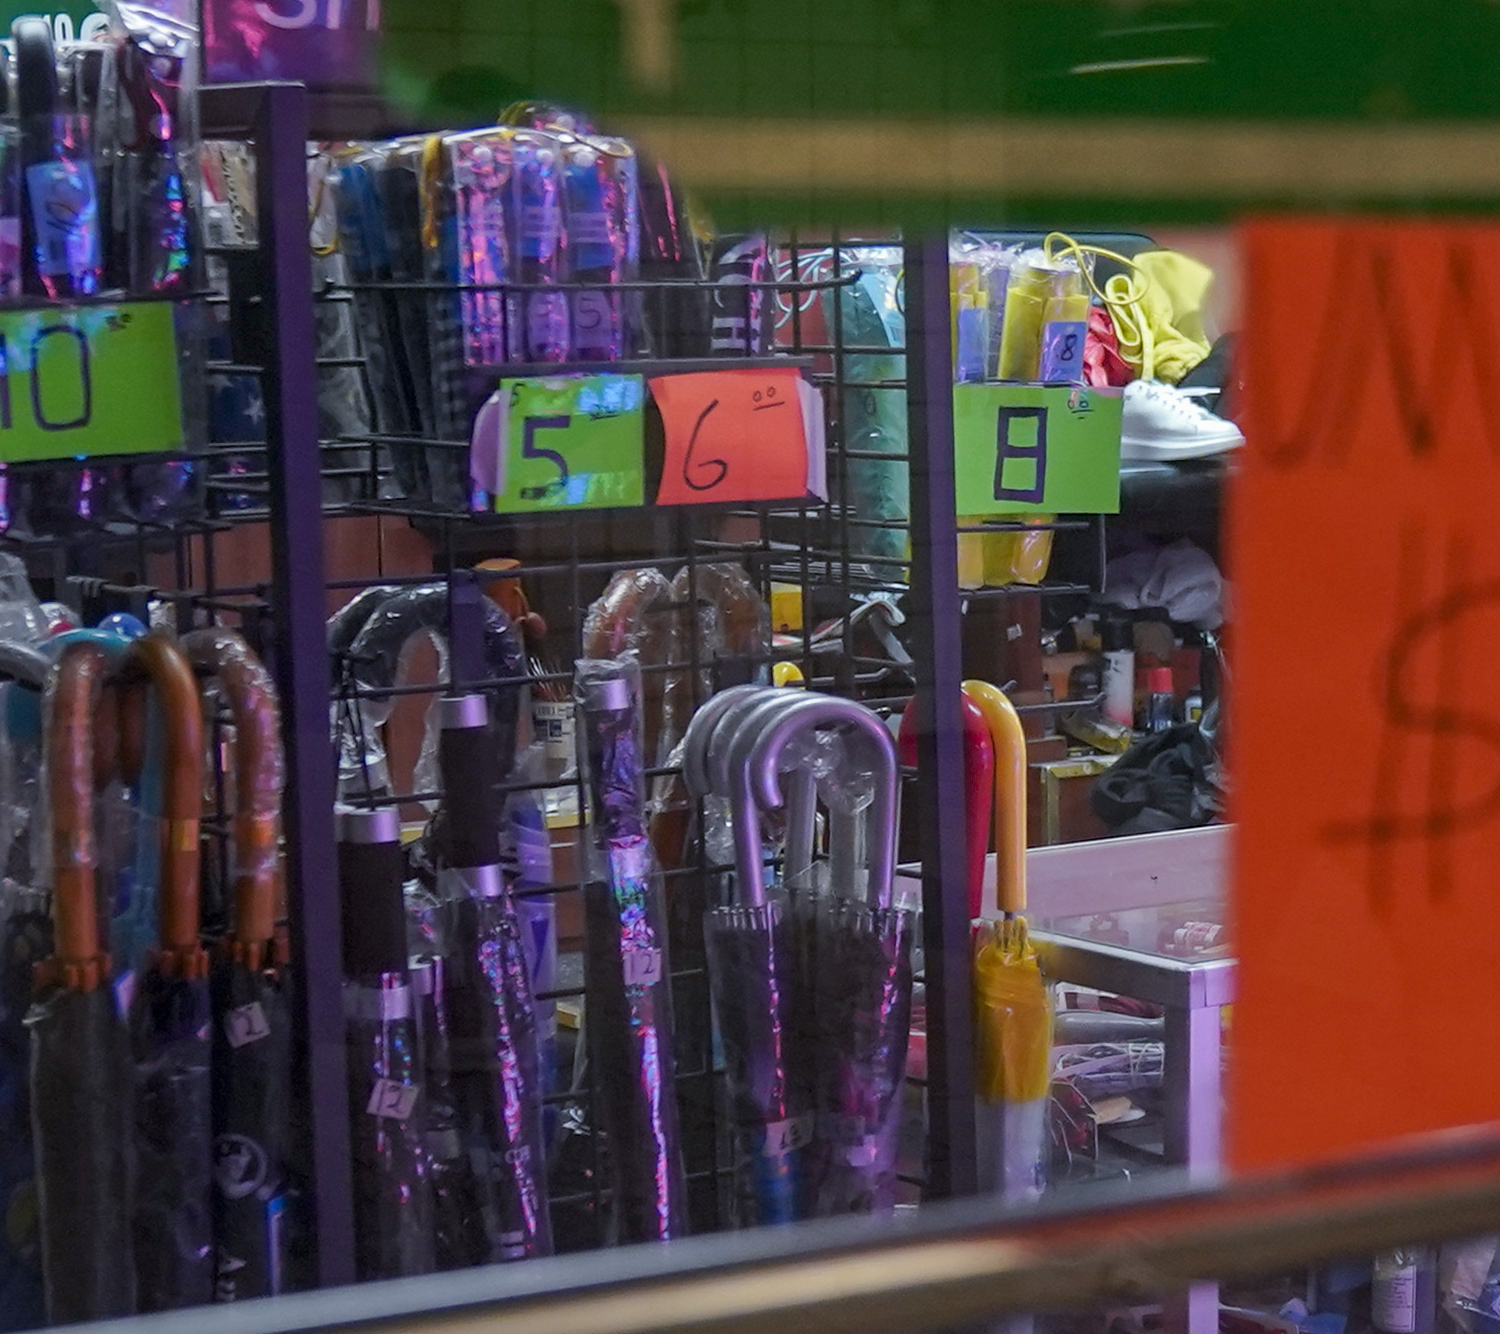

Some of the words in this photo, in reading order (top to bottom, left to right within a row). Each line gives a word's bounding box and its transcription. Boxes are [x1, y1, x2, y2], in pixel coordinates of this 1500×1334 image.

[521, 415, 571, 489] 5
[683, 400, 728, 492] 6
[992, 405, 1048, 504] 8
